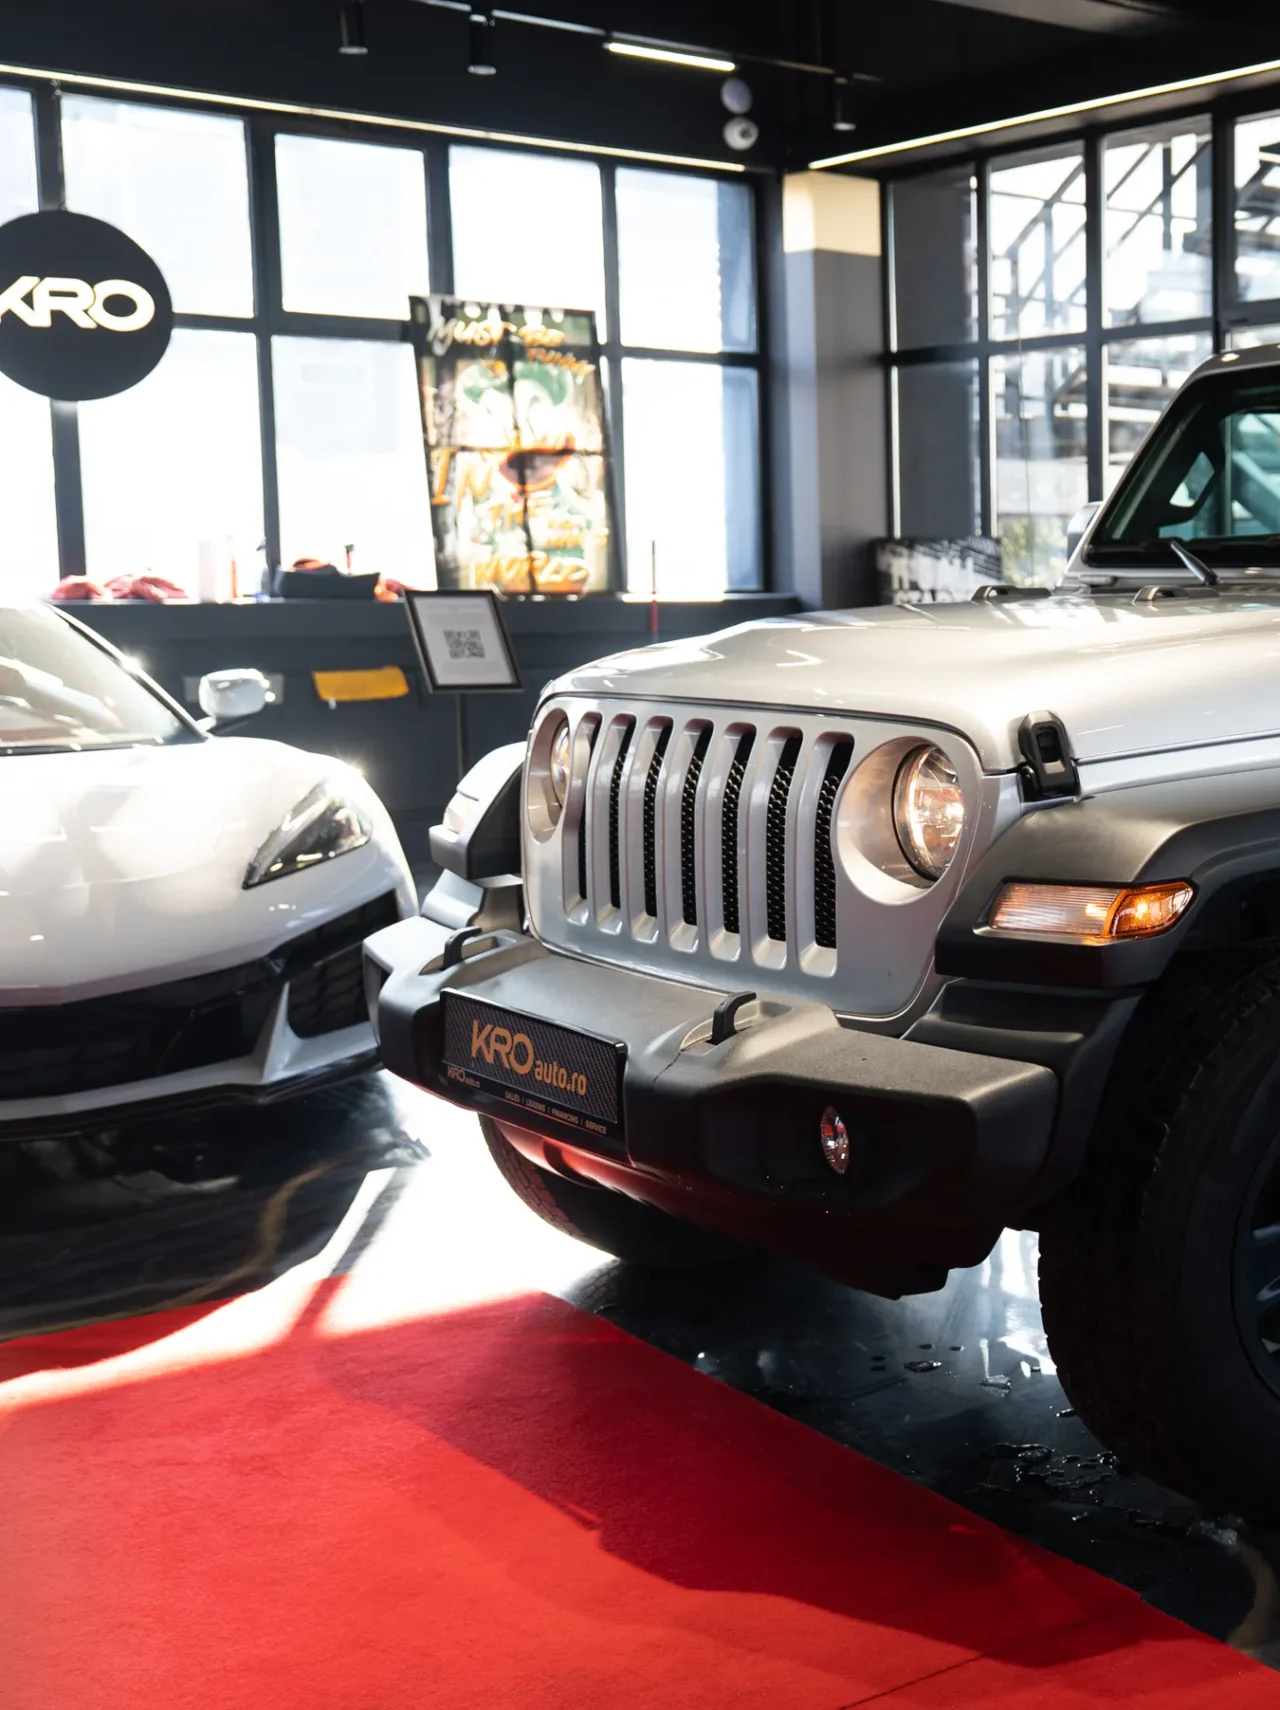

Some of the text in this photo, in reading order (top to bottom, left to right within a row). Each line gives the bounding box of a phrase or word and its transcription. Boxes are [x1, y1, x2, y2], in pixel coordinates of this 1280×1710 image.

[0, 276, 155, 332] KRO
[447, 1065, 465, 1083] KRO
[471, 1018, 588, 1096] KRO auto.ro
[585, 1119, 607, 1135] SERVICE
